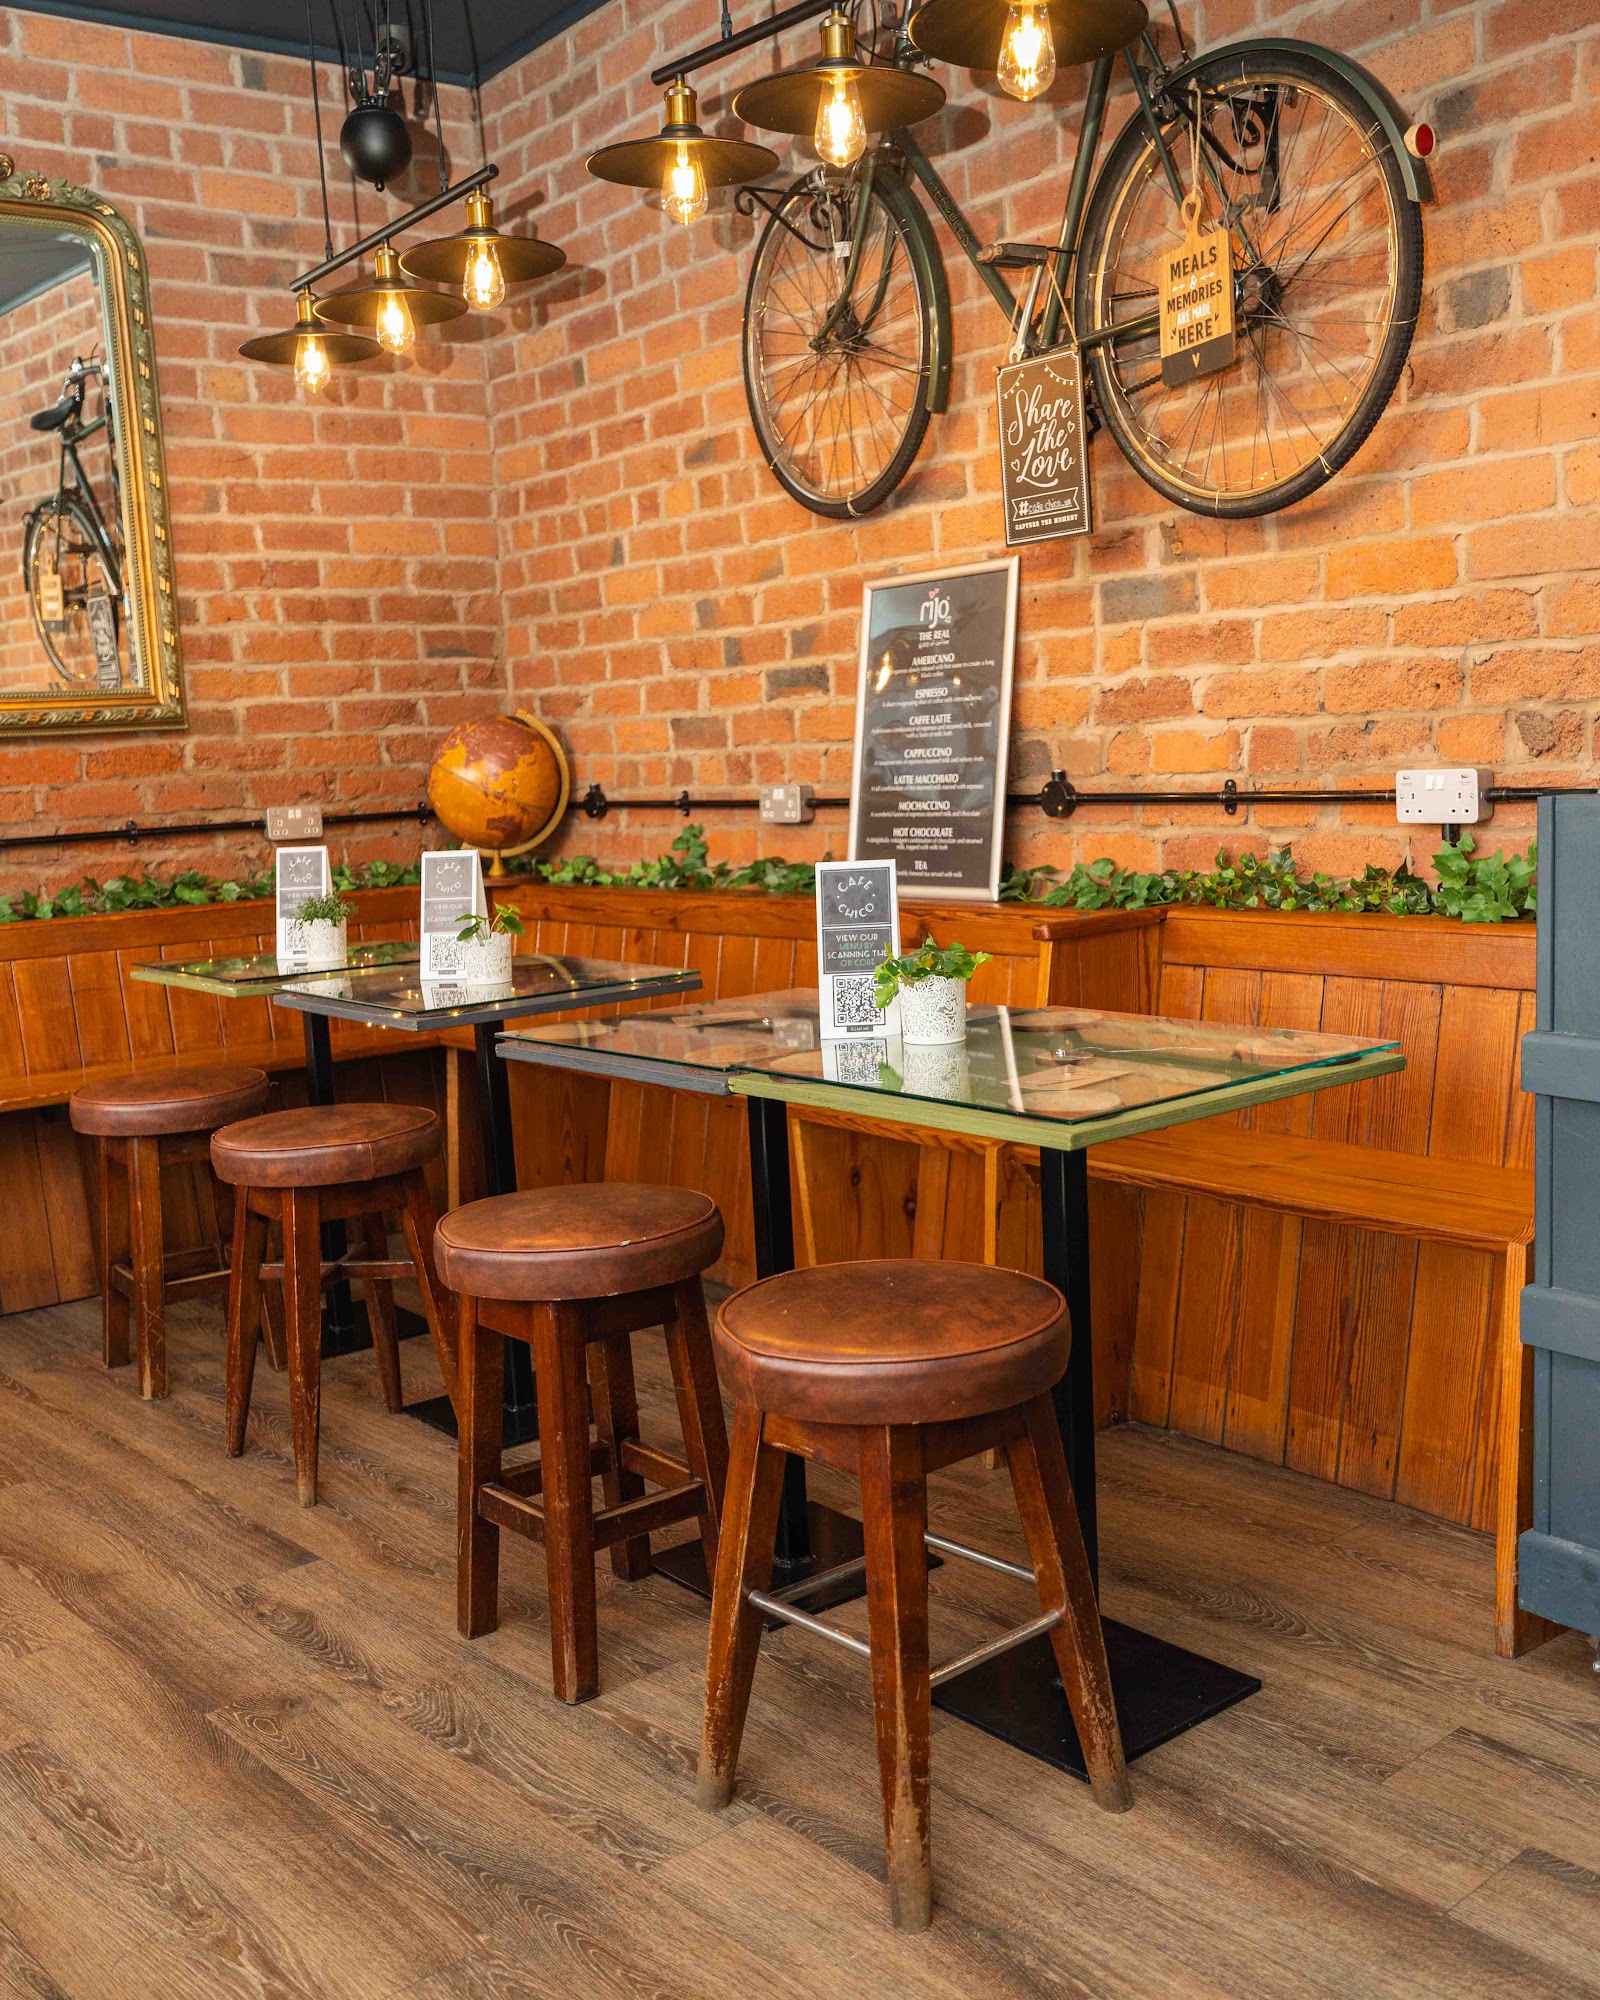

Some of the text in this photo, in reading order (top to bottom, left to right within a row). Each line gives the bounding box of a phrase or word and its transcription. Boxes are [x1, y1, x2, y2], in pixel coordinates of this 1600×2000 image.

[1169, 246, 1218, 281] MEALS
[1189, 275, 1198, 290] &
[1167, 279, 1223, 314] MEMORIES
[1177, 301, 1212, 326] ARE MADE
[1178, 318, 1213, 348] HERE
[1006, 384, 1074, 446] Share
[1034, 419, 1068, 454] the
[1016, 438, 1076, 487] Love
[1015, 513, 1079, 531] CAPTURE THE MOMENT
[918, 629, 951, 641] THE REAL
[911, 653, 956, 667] AMERICANO
[915, 687, 949, 699] ESPRESSO
[930, 714, 952, 725] LATTE
[903, 747, 952, 759] CAPPUCCINO
[893, 773, 960, 785] LATTE MACCHIATO
[897, 800, 951, 811] MOCHACCINO
[892, 827, 954, 838] HOT CHOCOLATE
[913, 860, 928, 871] TEA
[436, 881, 461, 894] CHICO
[838, 875, 873, 893] CAFE
[838, 902, 875, 919] CHICO
[836, 933, 878, 942] VIEW OUR
[840, 941, 874, 951] MENU BY
[827, 949, 888, 959] SCANNING THE
[854, 958, 875, 967] CODE
